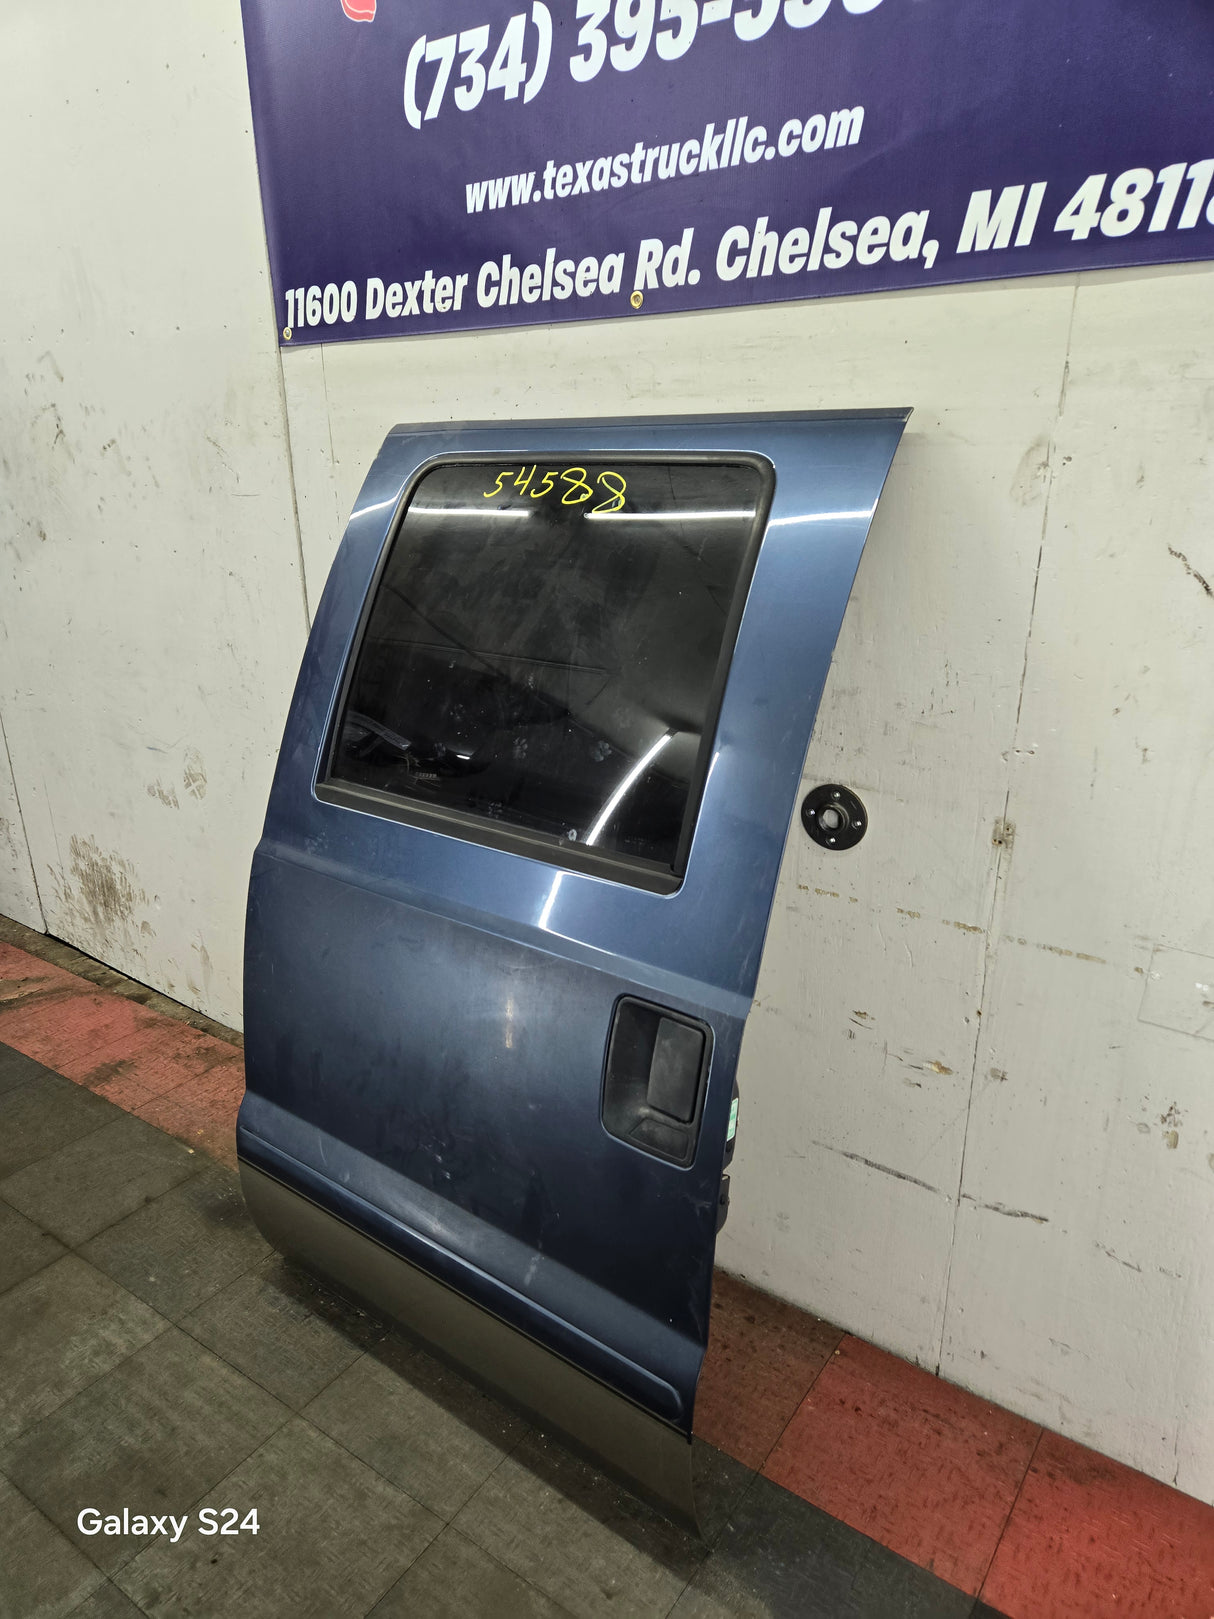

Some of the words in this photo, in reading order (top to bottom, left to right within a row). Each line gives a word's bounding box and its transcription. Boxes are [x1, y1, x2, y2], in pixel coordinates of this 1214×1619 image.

[404, 1, 552, 130] (734)
[465, 106, 865, 214] www.texastruckllc.com
[284, 280, 358, 328] 11600
[365, 269, 468, 320] Dexter
[476, 247, 626, 309] Chelsea
[633, 227, 701, 291] Rd.
[715, 206, 940, 282] Chelsea,
[955, 181, 1048, 254] MI
[1053, 158, 1214, 241] 4811
[483, 464, 627, 514] 54588
